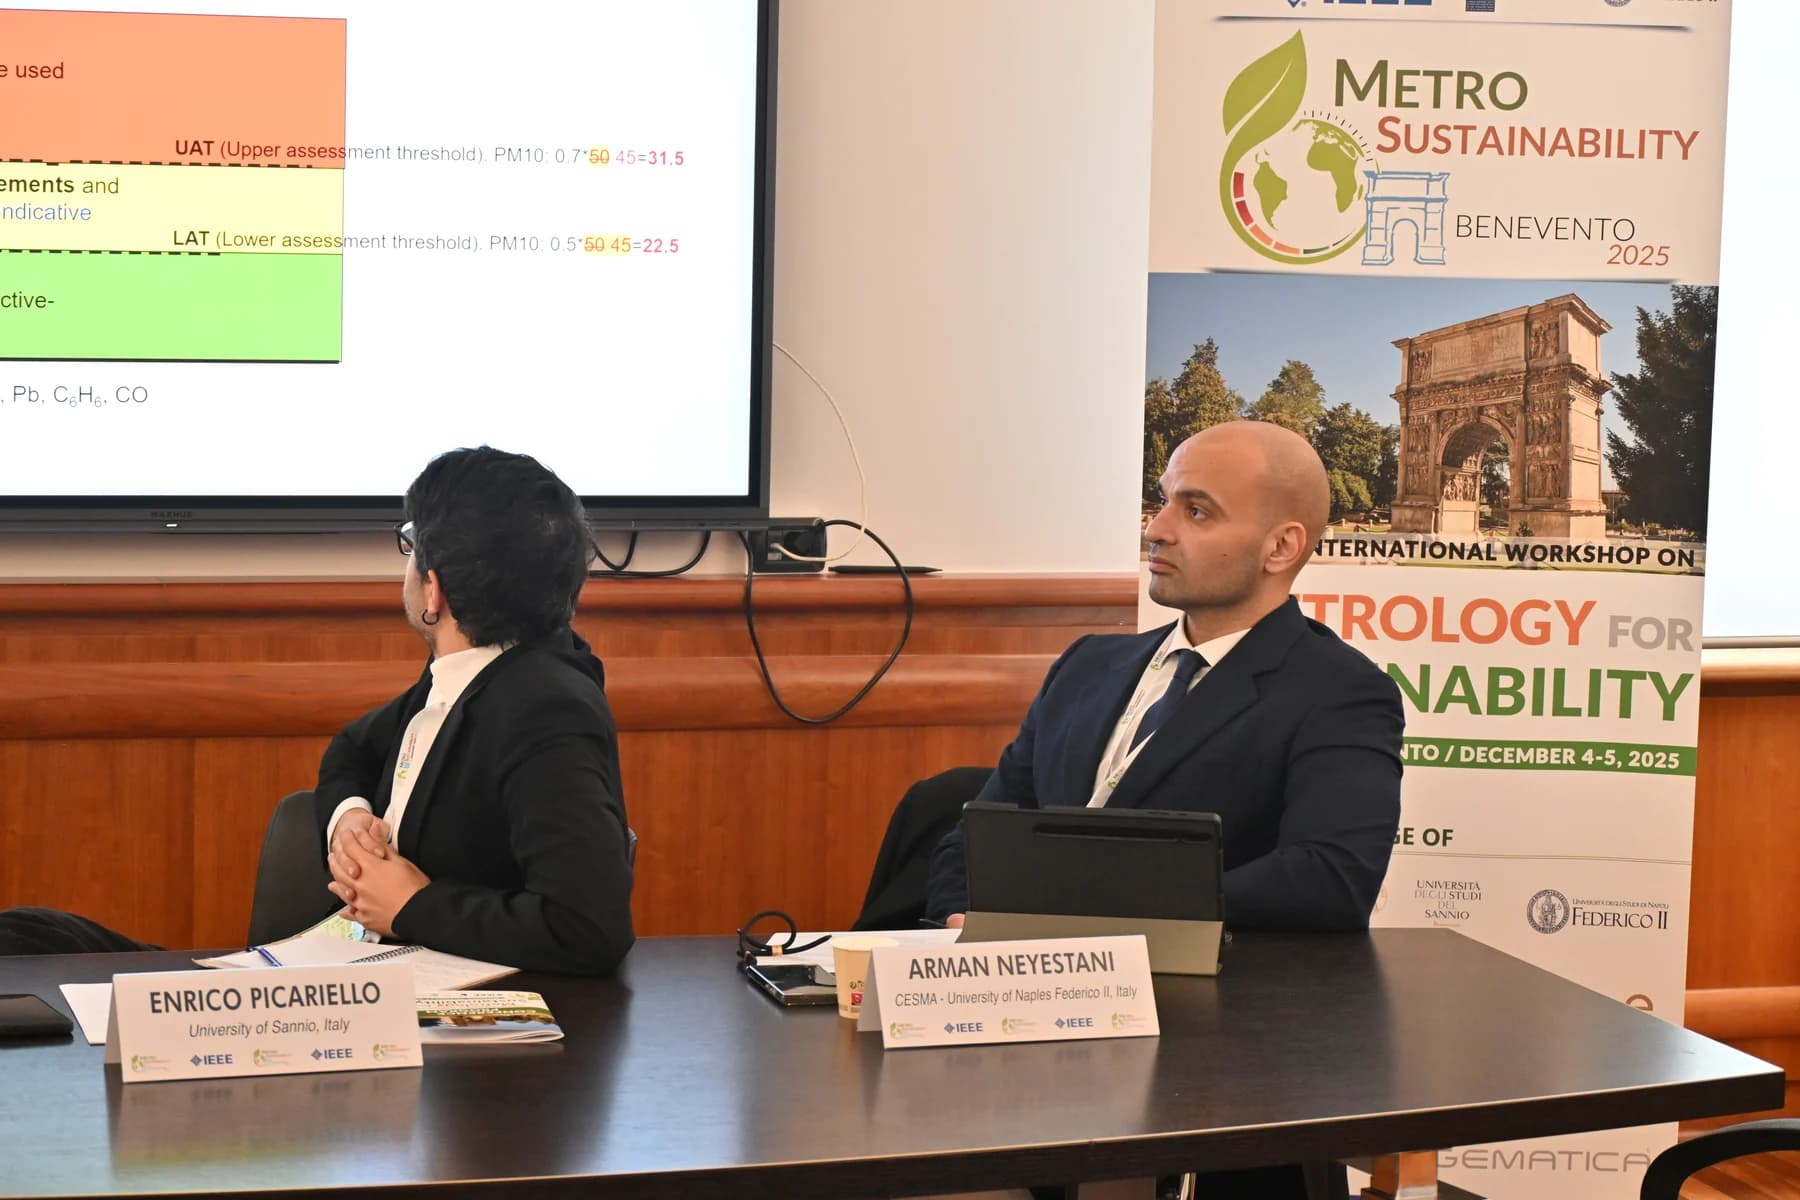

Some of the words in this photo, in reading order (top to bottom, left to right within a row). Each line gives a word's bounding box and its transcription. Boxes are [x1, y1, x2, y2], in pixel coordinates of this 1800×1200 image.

[16, 62, 64, 78] used
[1334, 58, 1529, 111] METRO
[1375, 116, 1699, 161] SUSTAINABILITY
[175, 140, 214, 156] UAT
[220, 141, 280, 160] (Upper
[286, 145, 390, 160] assessment
[495, 147, 549, 163] PM10:
[82, 177, 119, 194] and
[2, 203, 92, 221] ndicative
[1455, 214, 1636, 243] BENEVENTO
[173, 231, 210, 246] LAT
[216, 231, 276, 249] (Lower
[282, 234, 386, 249] assessment
[490, 235, 544, 252] PM10:
[1606, 244, 1671, 267] 2025
[0, 291, 55, 308] ctive-
[13, 385, 45, 405] Pb,
[115, 386, 149, 403] CO
[1504, 544, 1651, 565] WORKSHOP
[1657, 549, 1695, 567] ON
[1296, 593, 1597, 646] TROLOGY
[1608, 615, 1695, 652] FOR
[1380, 663, 1695, 721] NABILITY
[1460, 746, 1576, 765] DECEMBER
[1581, 748, 1623, 769] 4-5,
[1628, 751, 1680, 769] 2025
[1422, 828, 1454, 847] OF
[1414, 890, 1447, 900] DEGLI
[1449, 891, 1482, 901] STUDI
[1437, 901, 1457, 910] DEL
[1425, 909, 1470, 920] SANNIO
[1572, 907, 1654, 929] FEDERICO
[1658, 911, 1668, 930] II
[909, 956, 990, 980] ARMAN
[996, 951, 1115, 976] NEYESTANI
[150, 988, 241, 1013] ENRICO
[250, 981, 381, 1009] PICARIELLO
[895, 992, 938, 1007] CESMA
[947, 989, 1001, 1006] University
[1002, 989, 1014, 1002] of
[1015, 987, 1051, 1004] Naples
[1055, 985, 1100, 1001] Federico
[1116, 983, 1137, 1000] Italy
[189, 1023, 252, 1038] University
[256, 1020, 269, 1034] of
[272, 1018, 320, 1034] Sannio,
[324, 1017, 350, 1033] Italy
[956, 1022, 983, 1033] IEEE
[1067, 1017, 1094, 1028] IEEE
[203, 1054, 233, 1065] IEEE
[324, 1048, 353, 1059] IEEE
